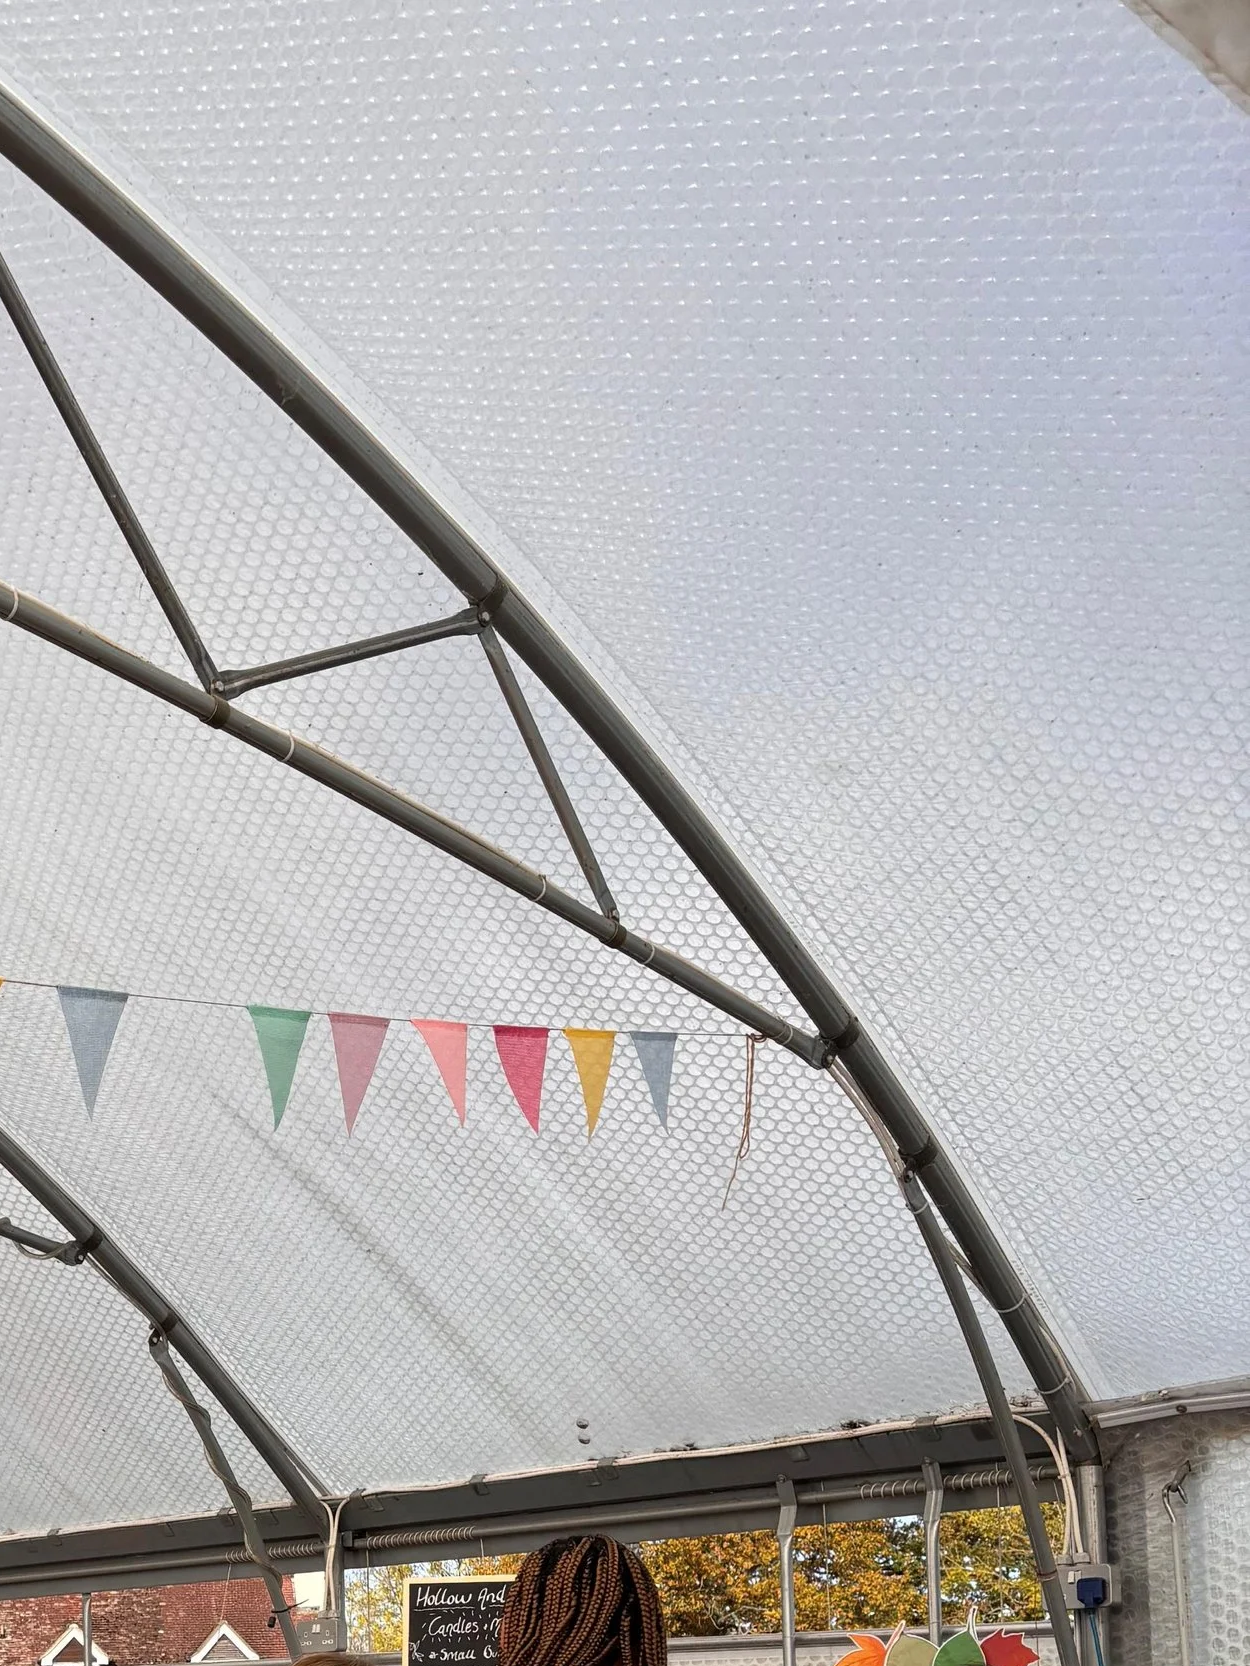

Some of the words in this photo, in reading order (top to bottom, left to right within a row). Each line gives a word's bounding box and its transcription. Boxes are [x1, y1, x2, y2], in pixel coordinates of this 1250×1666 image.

[416, 1586, 472, 1607] Hollow
[478, 1585, 507, 1610] And
[428, 1616, 479, 1637] Candles
[440, 1648, 476, 1661] Small
